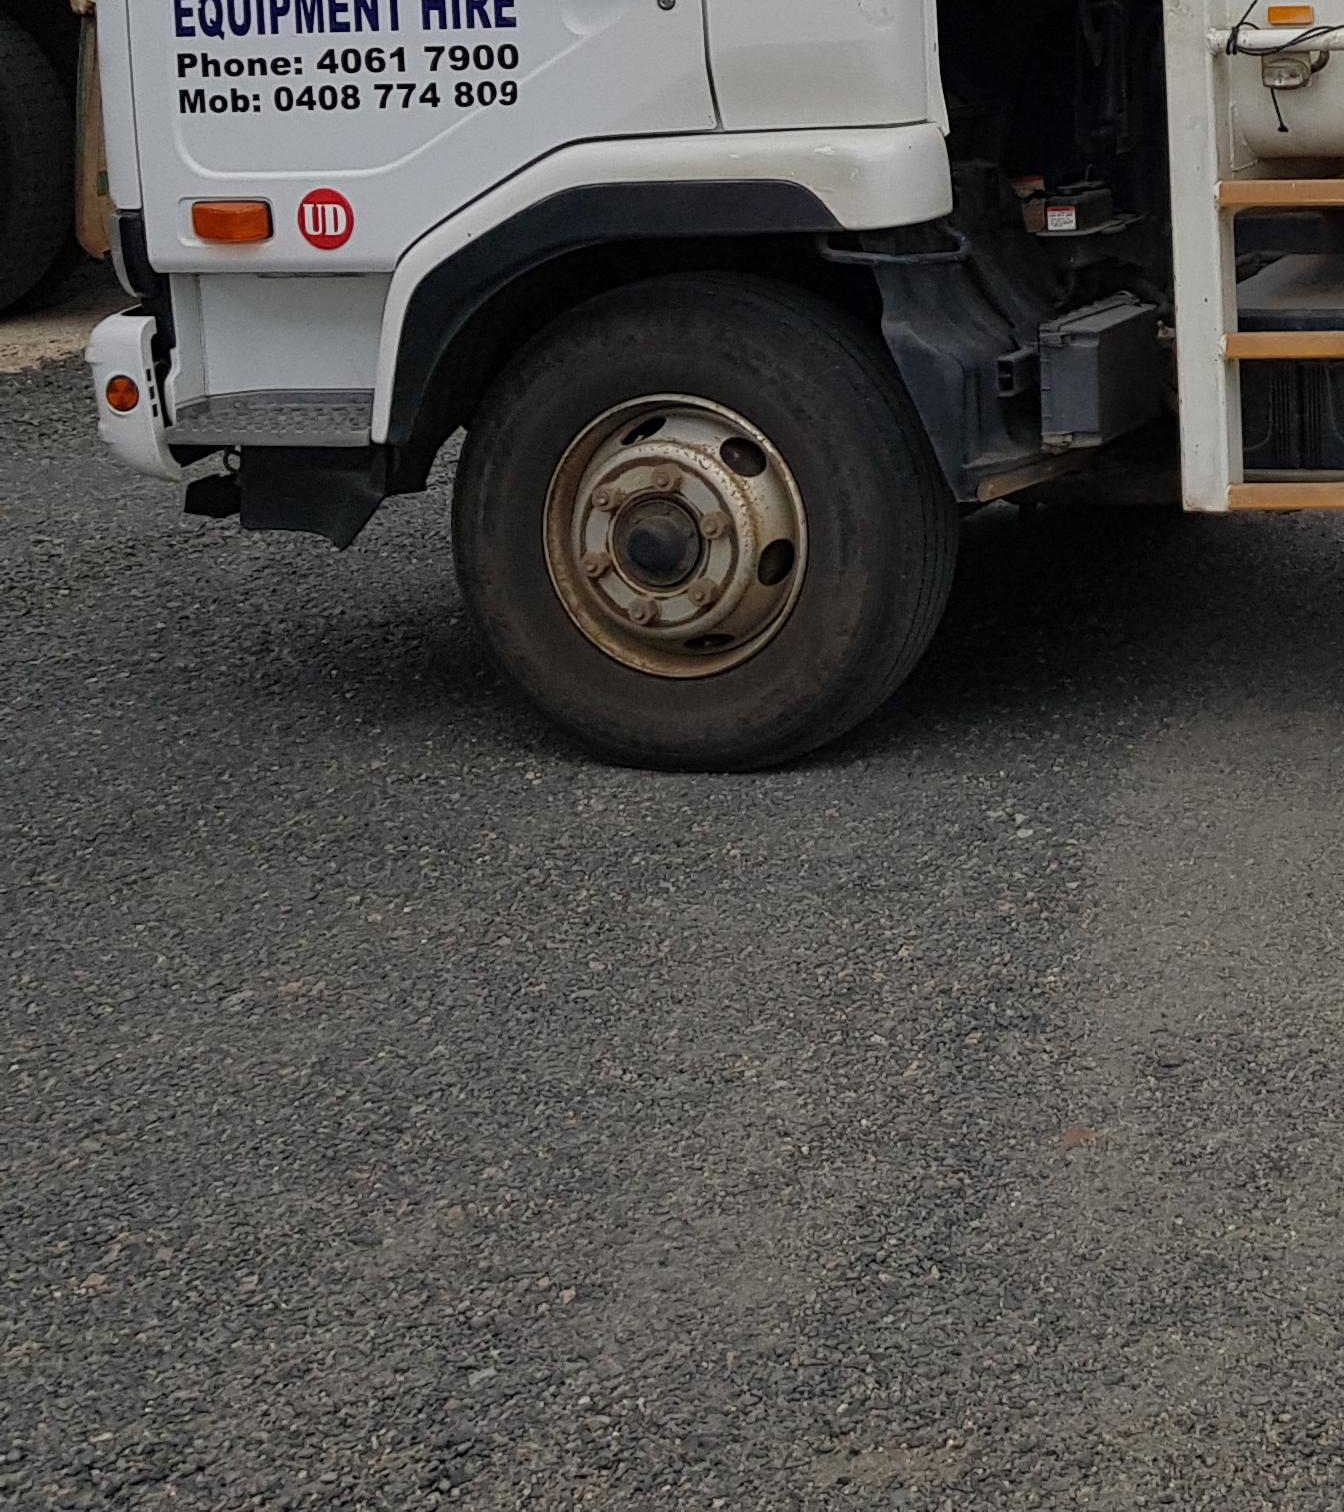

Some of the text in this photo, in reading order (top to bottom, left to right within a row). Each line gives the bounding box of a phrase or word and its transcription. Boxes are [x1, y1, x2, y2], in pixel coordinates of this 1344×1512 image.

[176, 44, 519, 78] Phone: 4061 7900
[178, 80, 518, 114] Mob: 0408 774 809
[302, 203, 347, 236] UD
